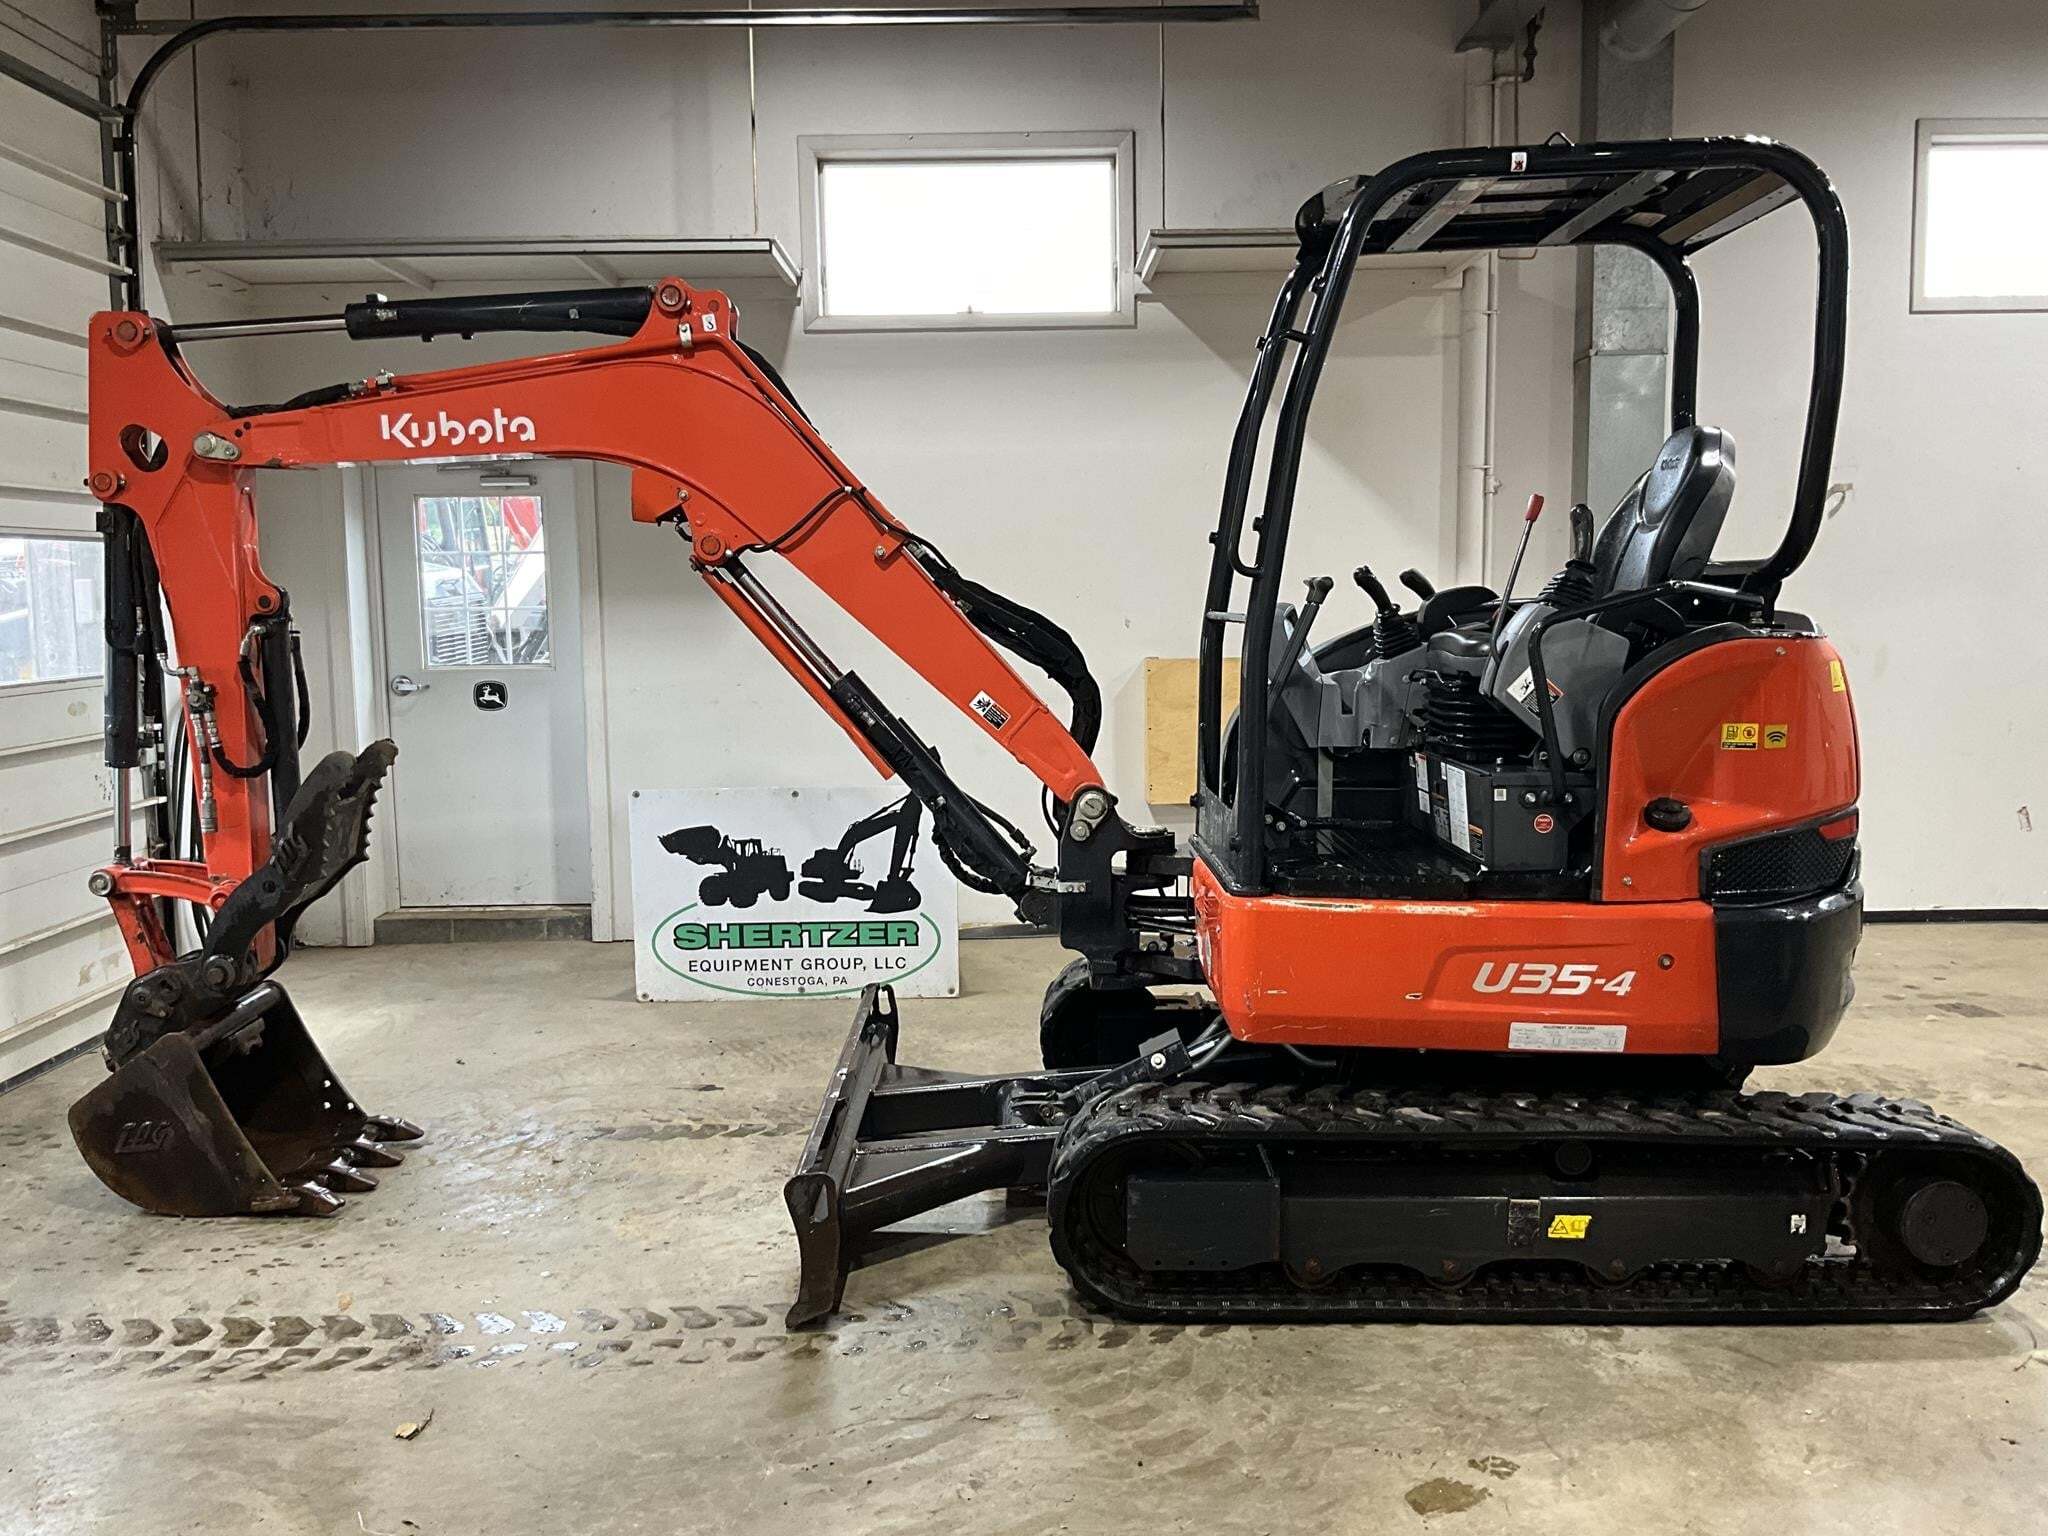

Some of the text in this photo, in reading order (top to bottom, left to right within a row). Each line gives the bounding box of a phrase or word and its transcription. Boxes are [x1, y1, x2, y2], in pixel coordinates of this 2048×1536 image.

[380, 408, 536, 448] Kubota
[673, 920, 919, 950] SHERTZER
[688, 956, 907, 973] EQUIPMENT GROUP, LLC
[1472, 962, 1637, 996] U35-4
[747, 976, 848, 987] CONESTOGA, PA
